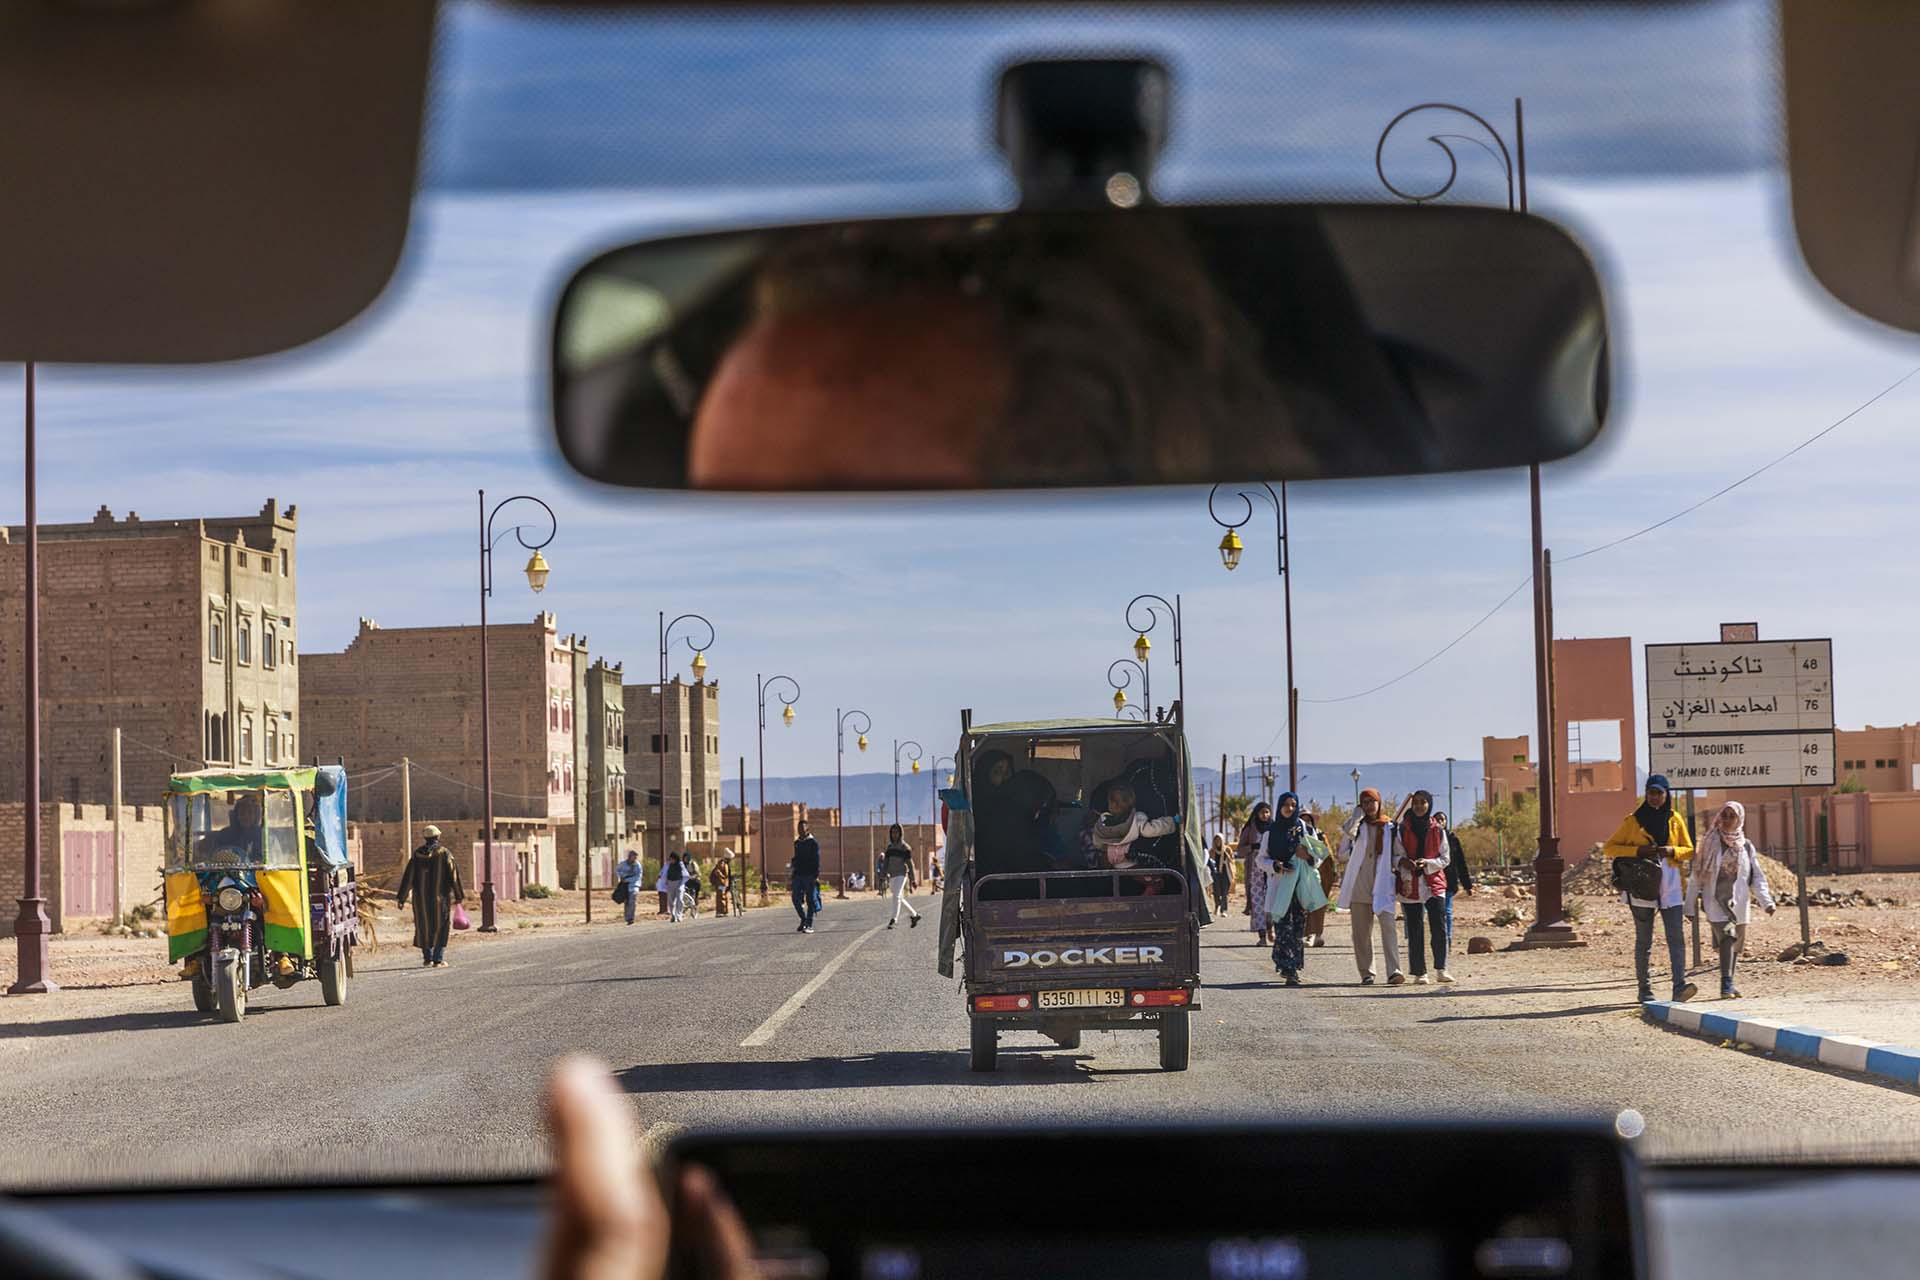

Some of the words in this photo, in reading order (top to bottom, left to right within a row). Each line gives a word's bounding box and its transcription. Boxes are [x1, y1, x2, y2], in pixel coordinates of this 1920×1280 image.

[1674, 656, 1763, 682] تاكونيت
[1802, 659, 1818, 670] 48
[1662, 698, 1716, 721] الغزلان
[1719, 696, 1777, 718] امحاميد
[1804, 700, 1819, 711] 76
[1692, 743, 1745, 756] TAGOUNITE
[1803, 744, 1818, 755] 48
[1710, 767, 1721, 777] EL
[1723, 765, 1771, 777] GHIZLANE
[1804, 765, 1818, 776] 76
[1003, 946, 1164, 968] DOCKER
[1043, 992, 1074, 1006] 5350
[1104, 991, 1121, 1004] 39
